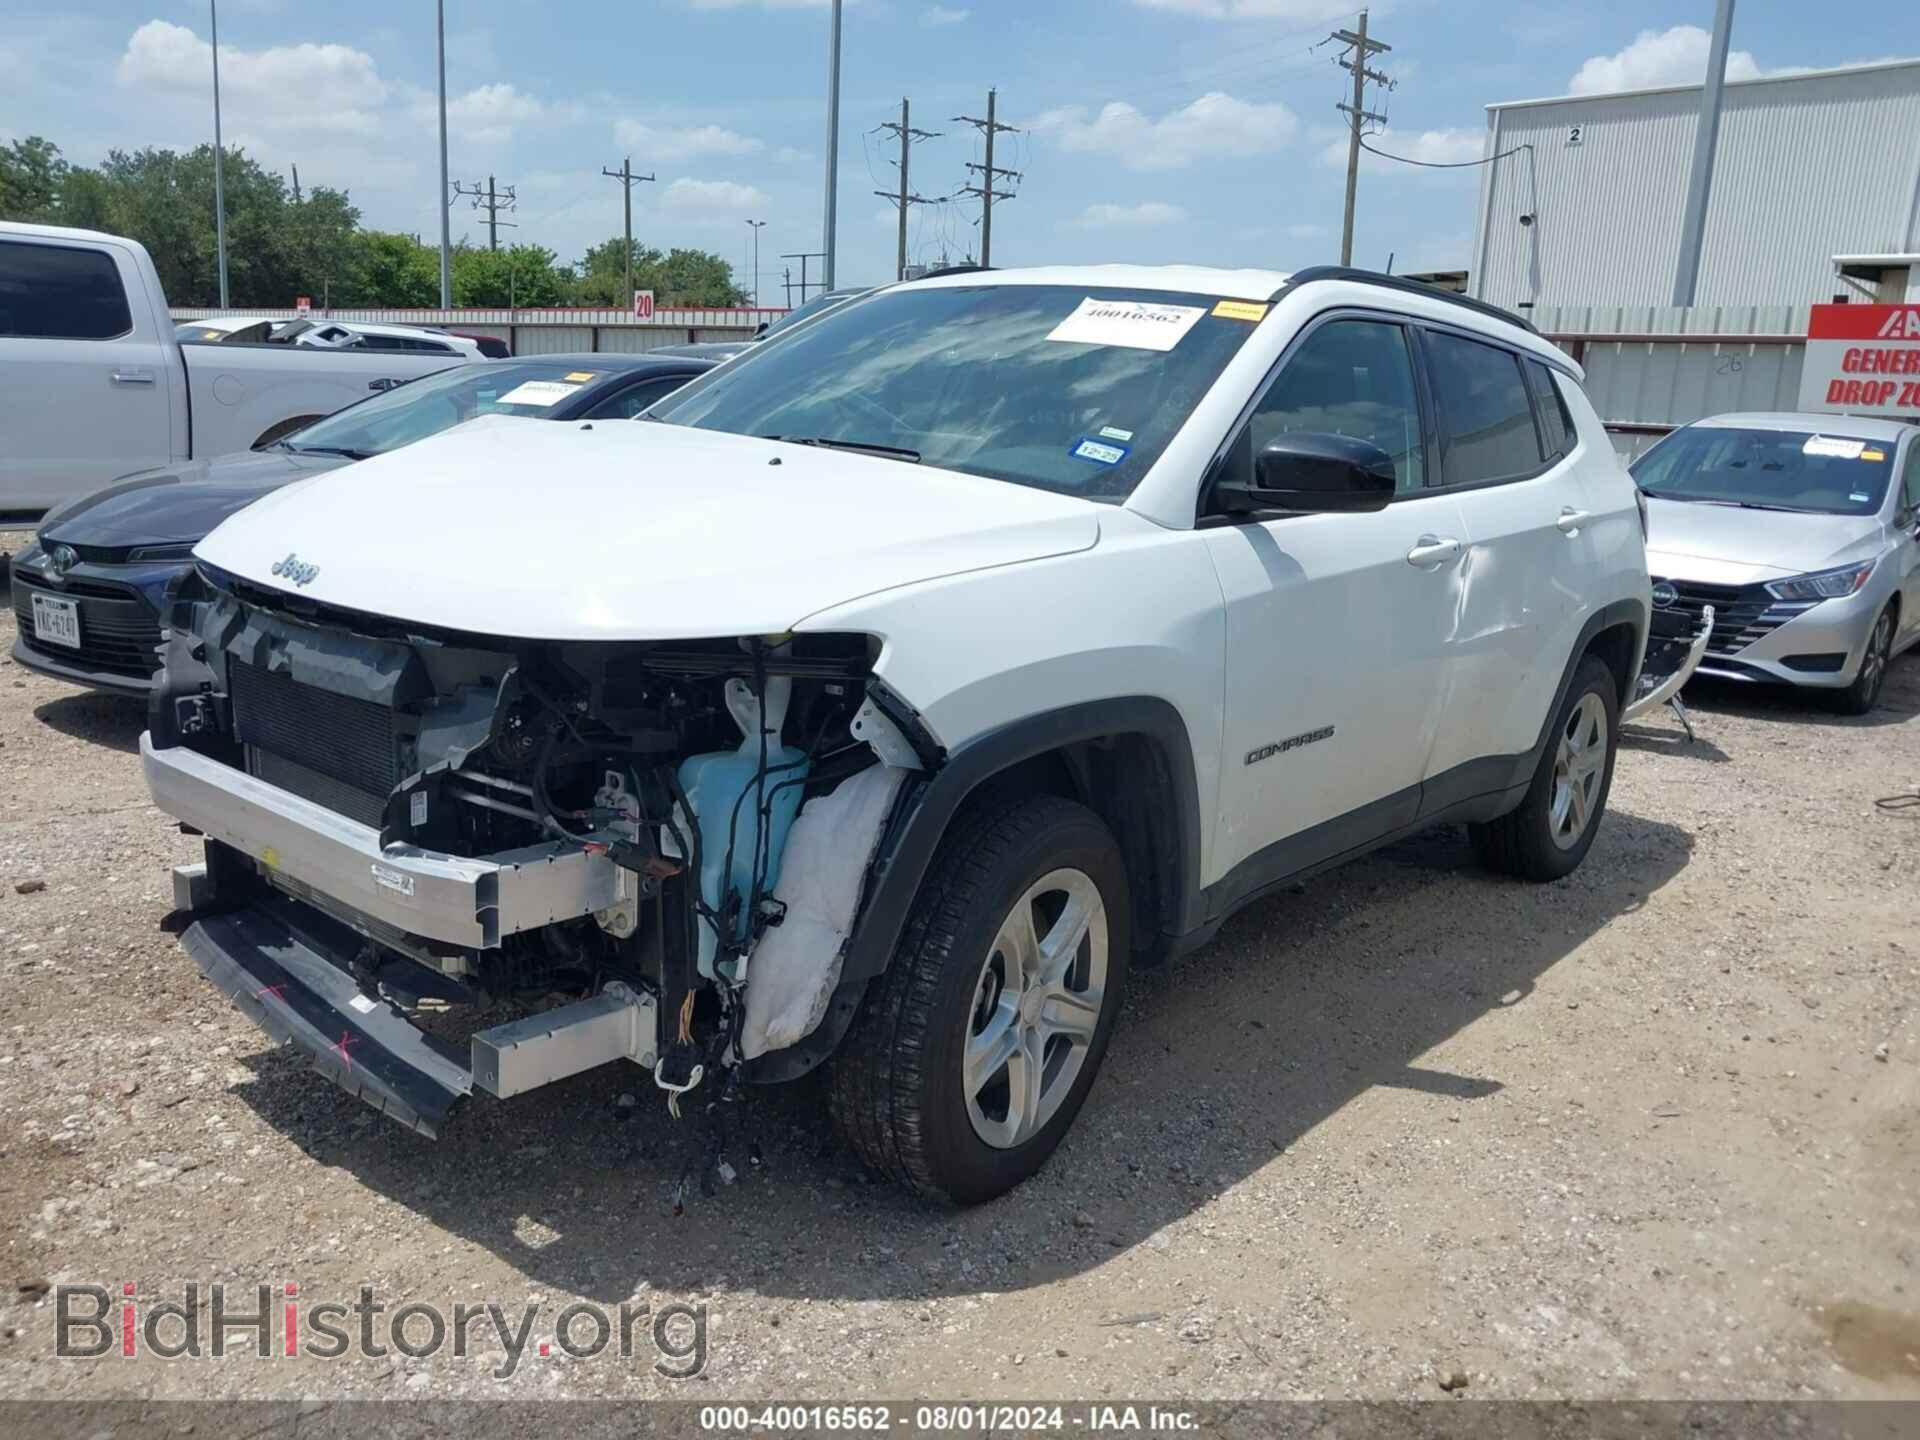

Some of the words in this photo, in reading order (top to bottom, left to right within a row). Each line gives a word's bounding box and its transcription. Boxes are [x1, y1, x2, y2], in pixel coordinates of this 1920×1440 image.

[1570, 129, 1580, 141] 2
[637, 296, 651, 317] 20
[1087, 310, 1182, 324] 40016562
[1826, 380, 1897, 406] DROP
[271, 553, 320, 588] Jeep
[1244, 724, 1335, 766] COMPASS
